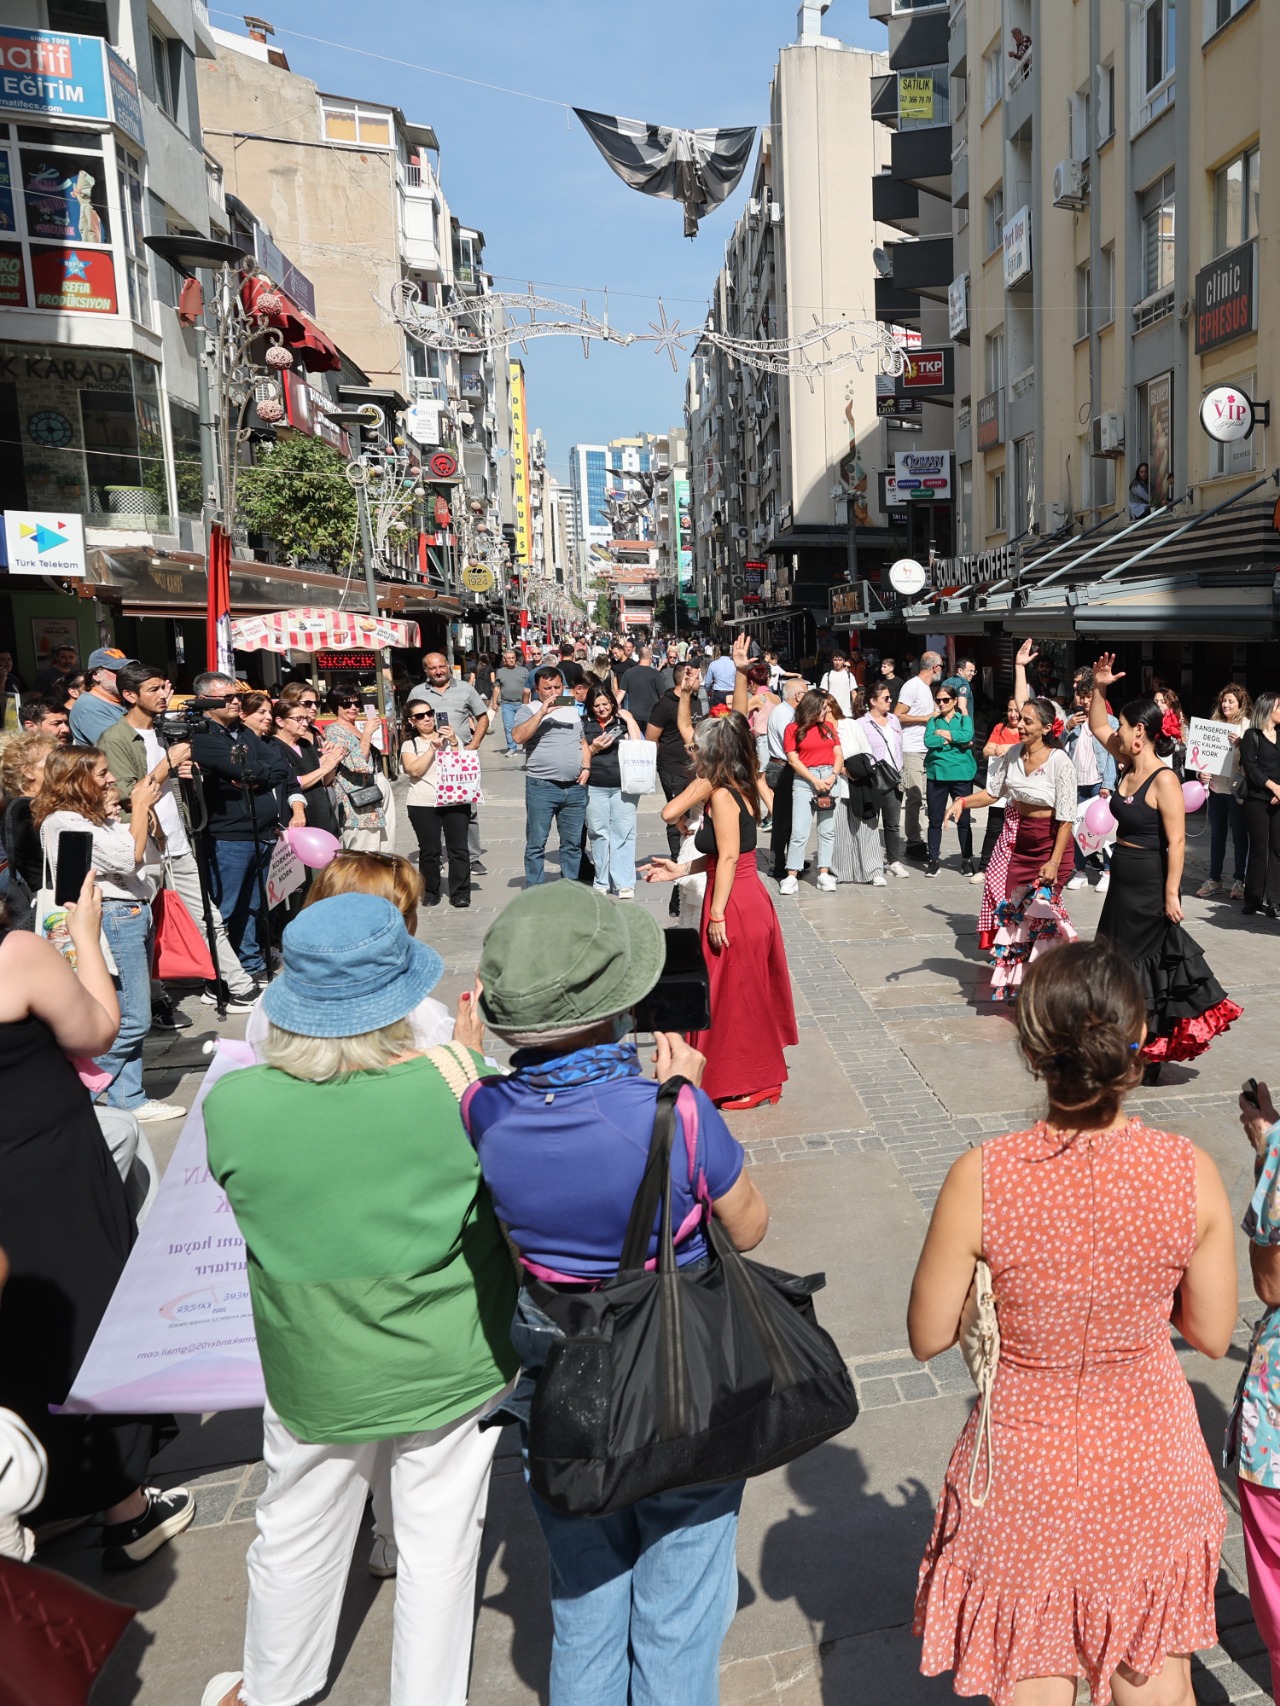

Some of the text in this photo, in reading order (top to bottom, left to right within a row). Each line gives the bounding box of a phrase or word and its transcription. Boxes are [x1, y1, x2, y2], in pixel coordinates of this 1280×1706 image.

[30, 35, 70, 46] since 1998
[3, 75, 84, 103] EĞİTİM
[903, 79, 931, 90] SATILIK
[1206, 262, 1241, 307] clinic
[1200, 293, 1248, 346] EPHESUS
[918, 360, 943, 373] TKP
[878, 406, 896, 414] LION
[512, 397, 522, 481] DALTON
[517, 494, 526, 549] KURS
[15, 559, 79, 570] Türk Telekom
[936, 545, 1016, 588] SOULMATE COFFEE
[467, 577, 488, 586] 1924
[1202, 733, 1221, 743] DEĞİL
[1202, 749, 1219, 758] KORK
